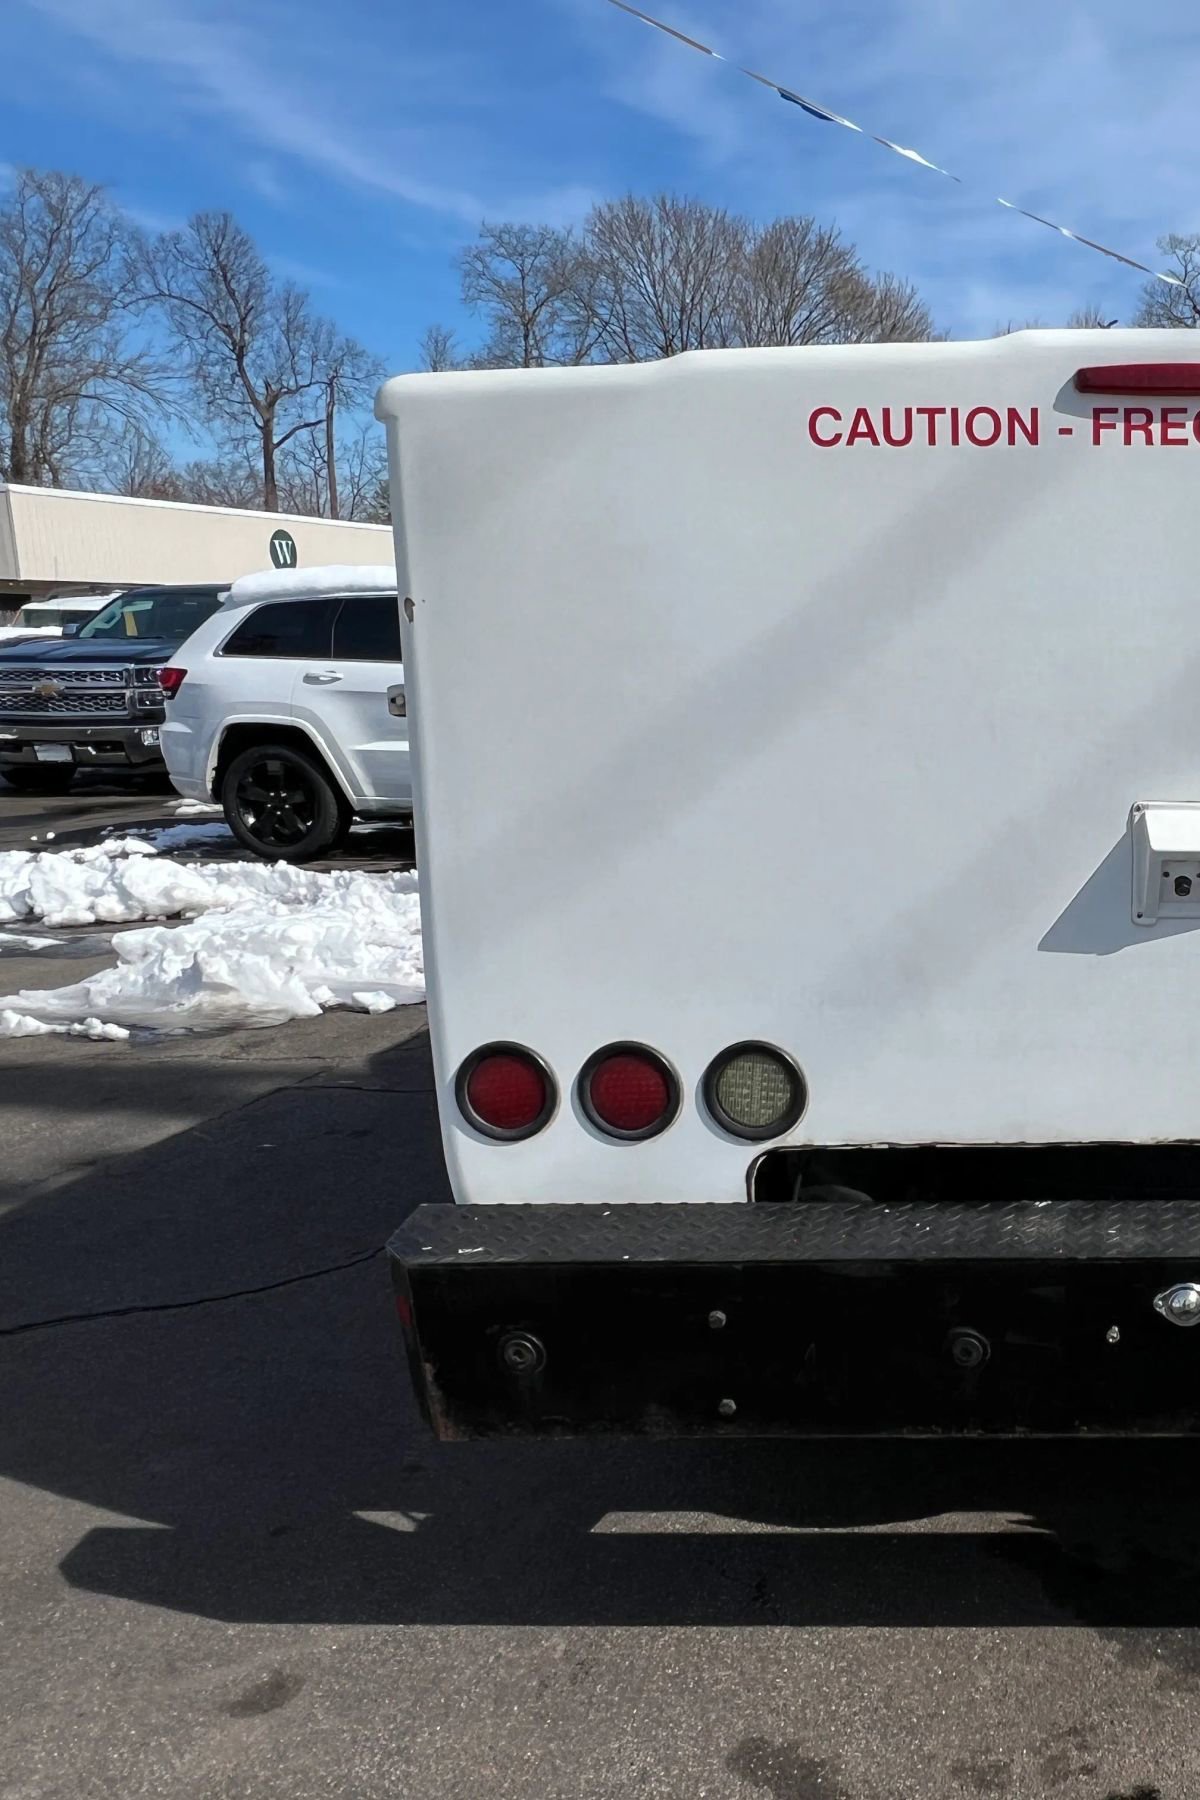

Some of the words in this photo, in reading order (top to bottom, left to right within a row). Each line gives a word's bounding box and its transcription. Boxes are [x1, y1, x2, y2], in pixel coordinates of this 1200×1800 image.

[808, 406, 1040, 447] CAUTION
[1058, 427, 1073, 436] -
[272, 539, 293, 565] W
